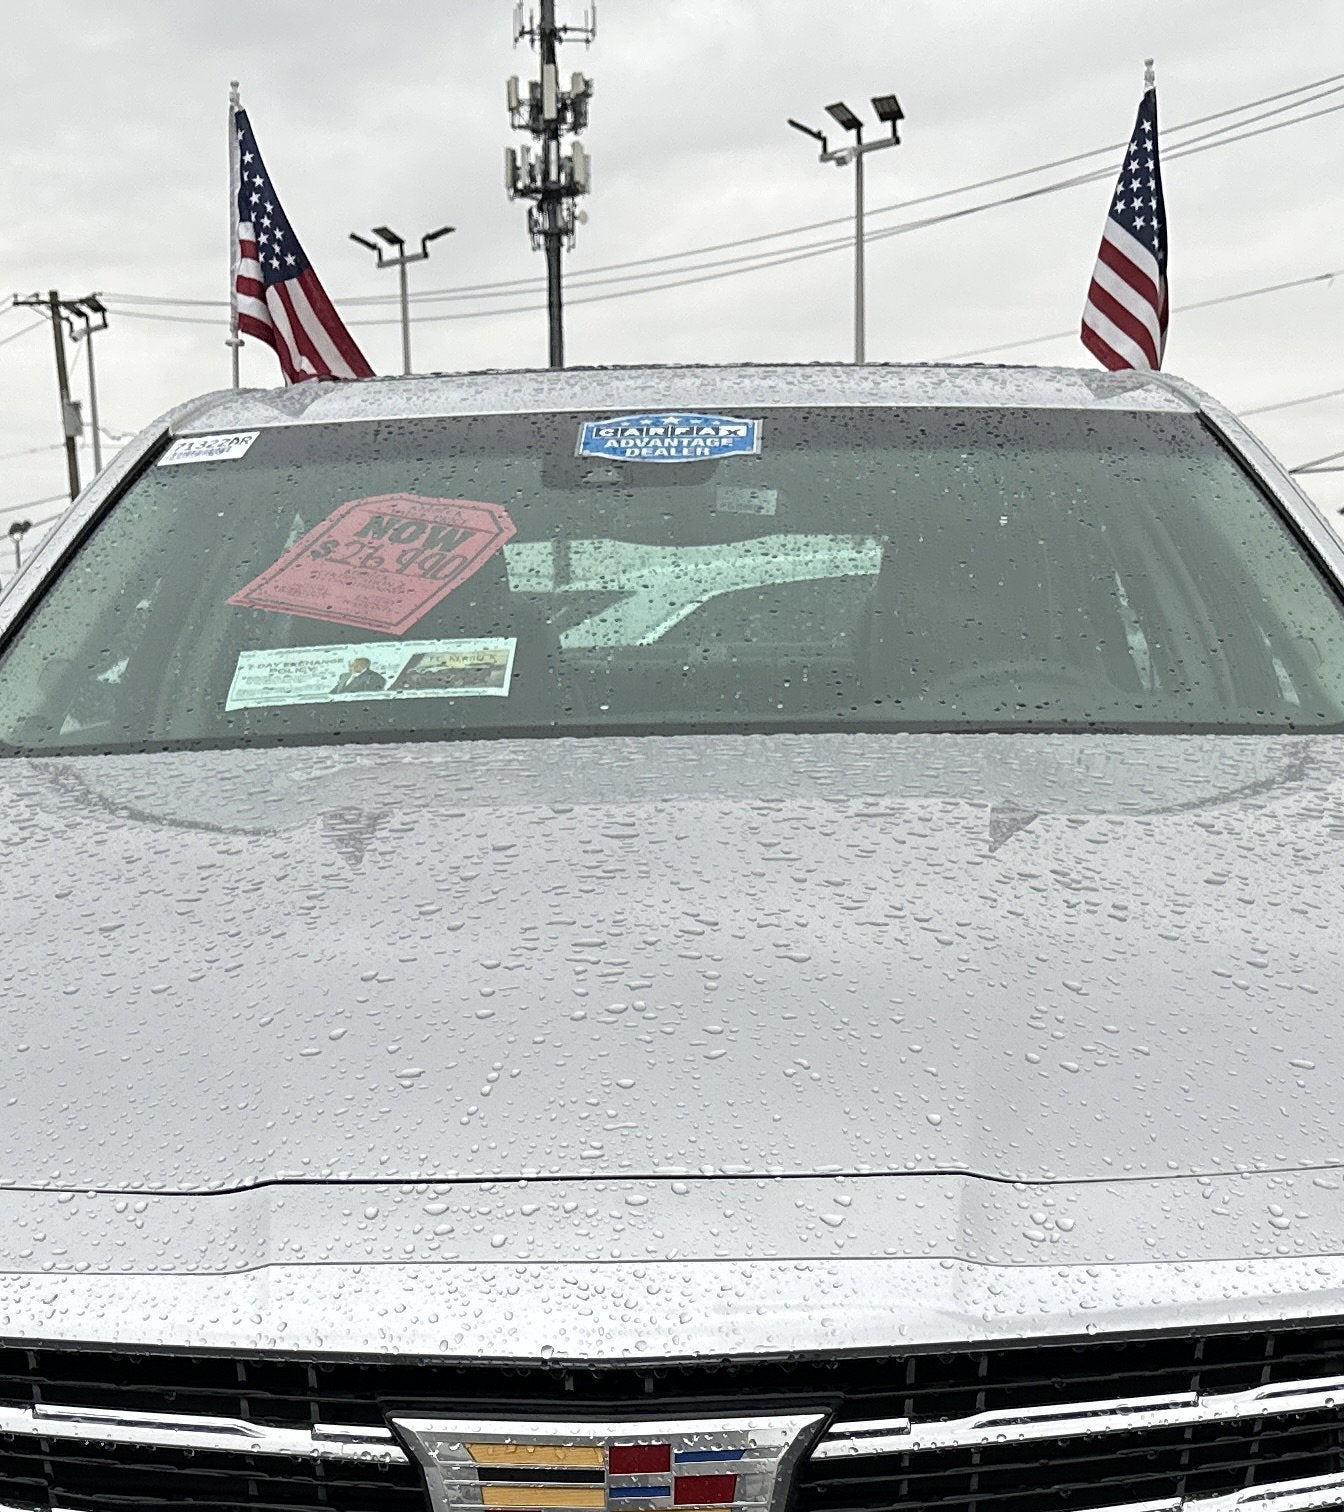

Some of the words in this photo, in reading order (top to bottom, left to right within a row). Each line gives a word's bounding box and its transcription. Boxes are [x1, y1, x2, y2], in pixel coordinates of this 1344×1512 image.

[594, 425, 747, 438] CARFAX
[603, 437, 734, 448] ADVANTAGE
[625, 447, 711, 457] DEALER
[353, 515, 476, 553] NOW
